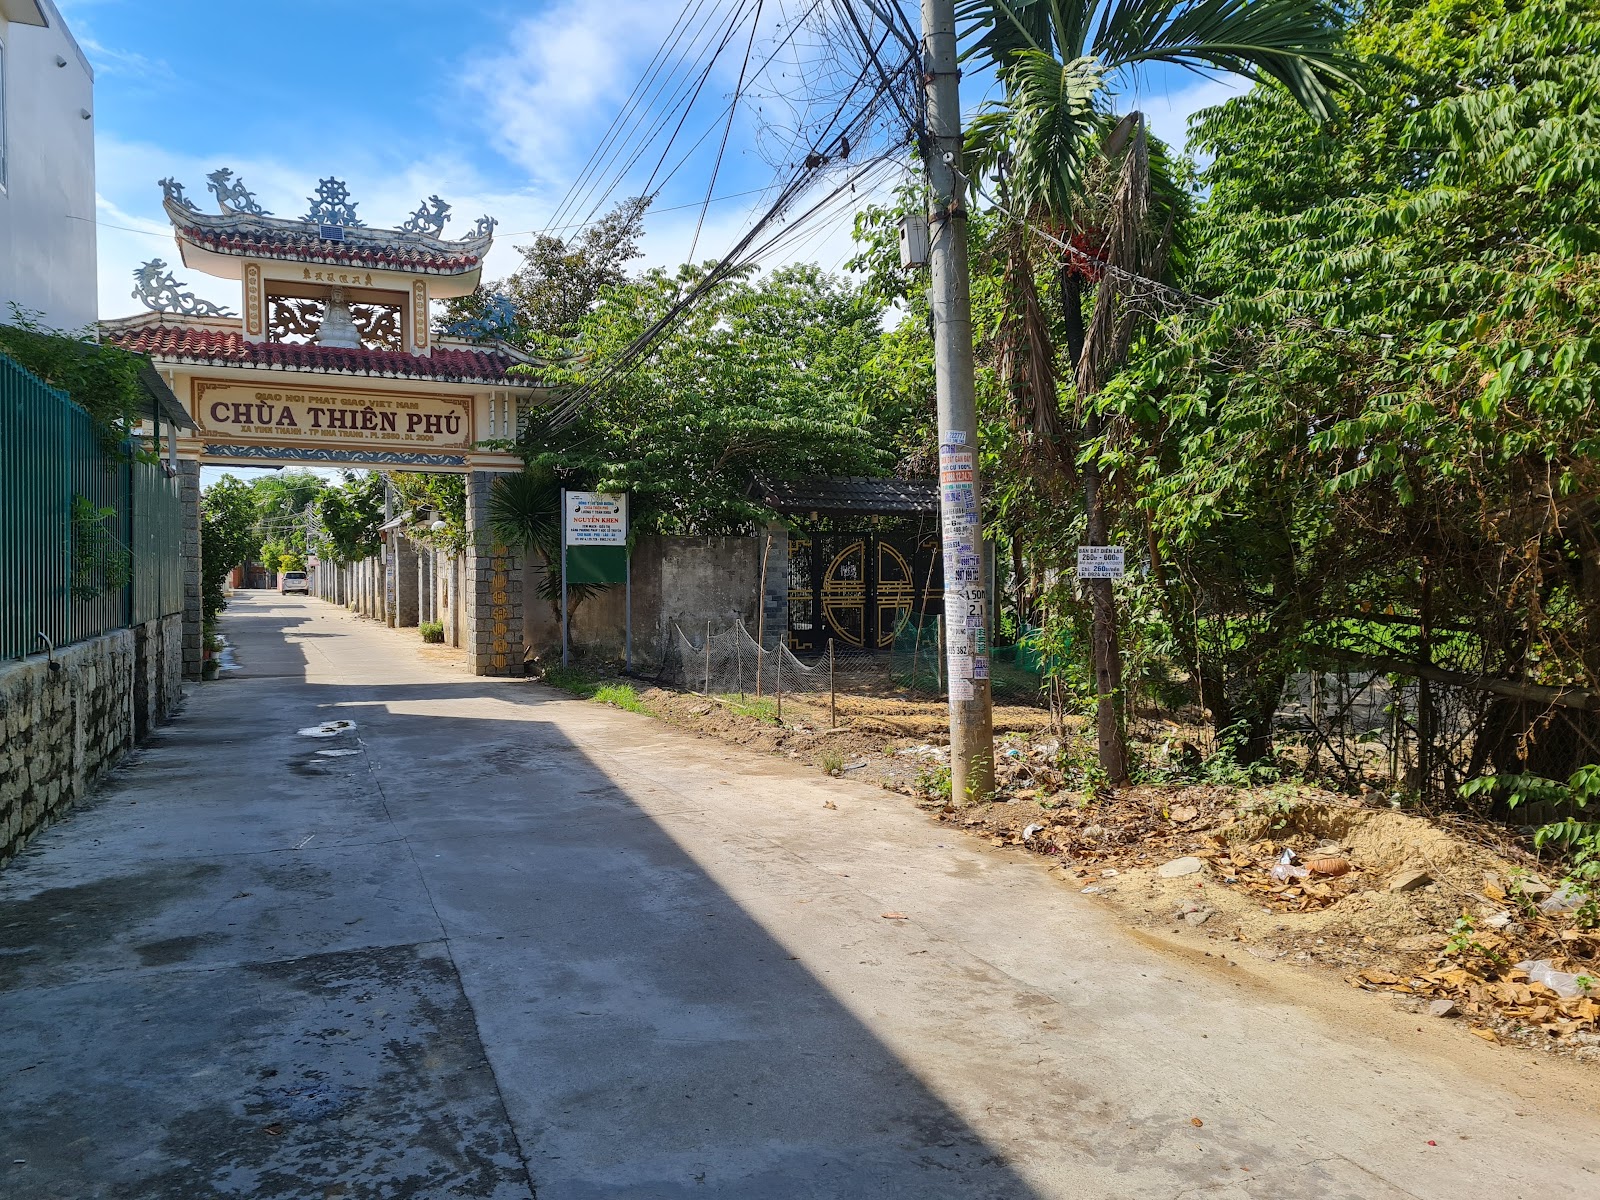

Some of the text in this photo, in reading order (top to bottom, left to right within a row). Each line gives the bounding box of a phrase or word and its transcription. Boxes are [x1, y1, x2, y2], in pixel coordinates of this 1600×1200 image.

[396, 402, 419, 410] NAM
[210, 400, 461, 435] CHÙA THIÊN PHÚ
[320, 429, 337, 437] NHA
[338, 430, 364, 438] TRANG
